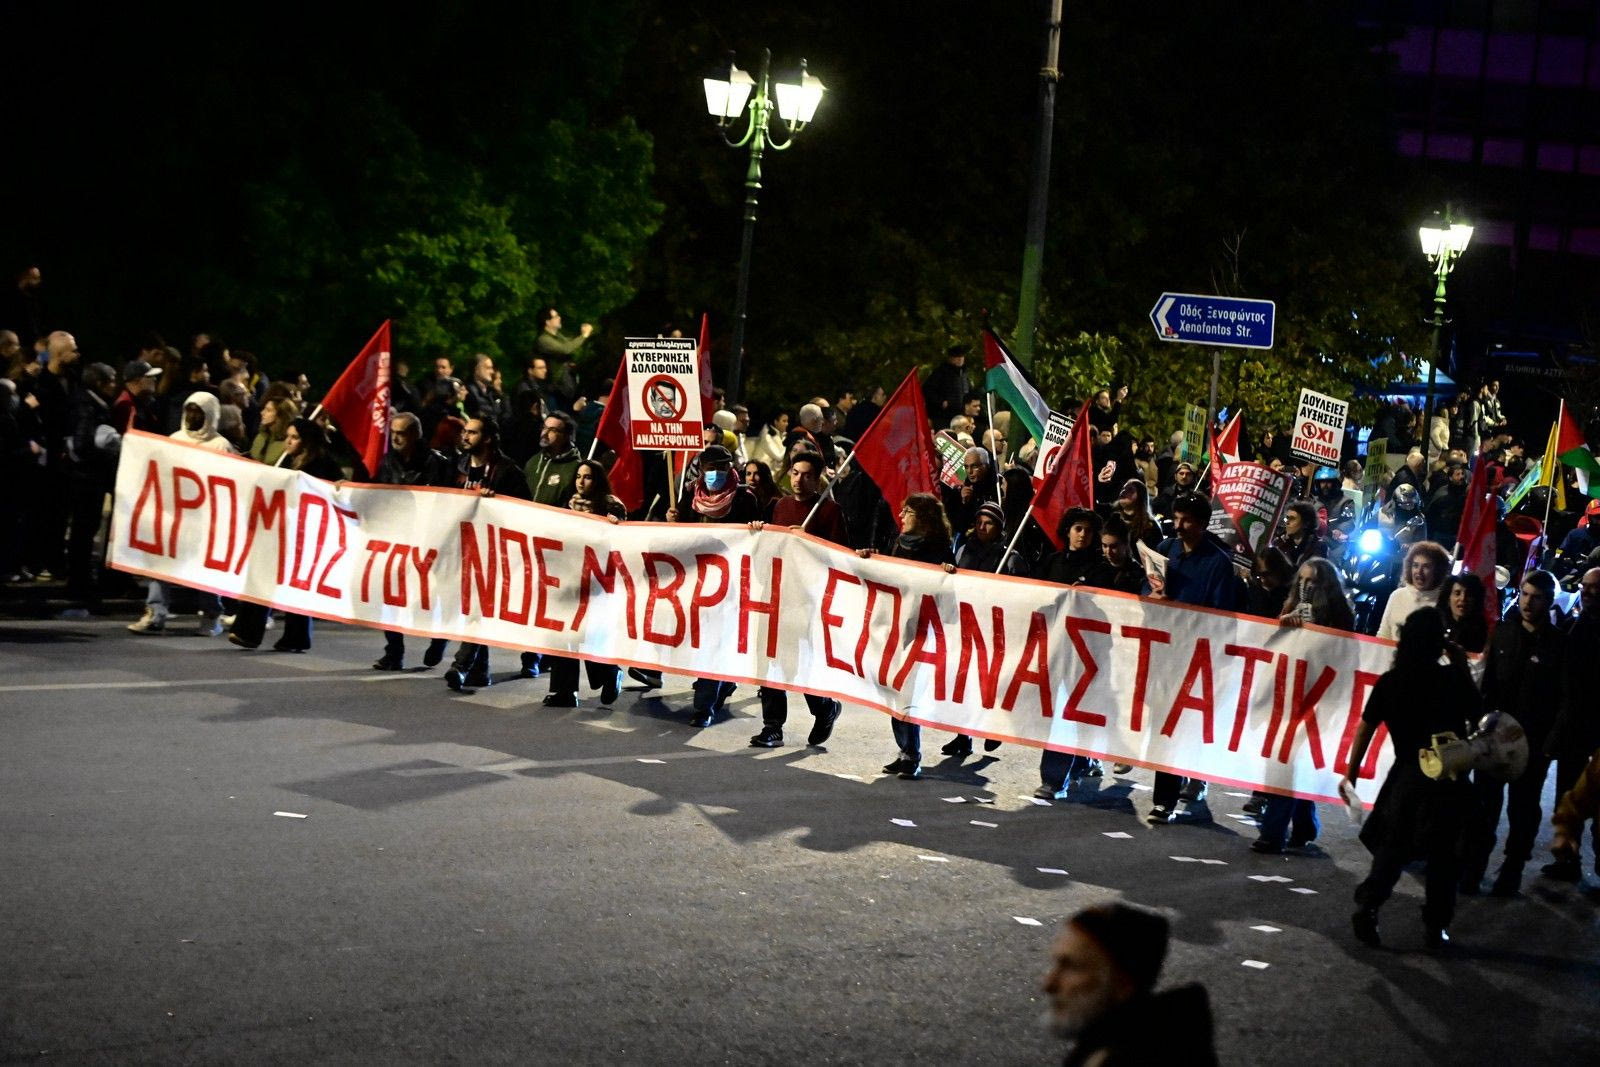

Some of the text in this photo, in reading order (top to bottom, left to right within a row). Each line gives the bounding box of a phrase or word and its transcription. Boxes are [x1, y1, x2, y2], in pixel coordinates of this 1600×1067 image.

[1180, 304, 1266, 325] Οδός Ξενοφώντος
[1179, 320, 1253, 338] Xenofontos Str.
[631, 363, 693, 374] ΔΟΛΟΦΟΝΩΝ
[632, 352, 690, 363] ΚΥΒΕΡΝΗΣΗ
[1302, 393, 1346, 417] ΔΟΥΛΕΙΕΣ
[650, 422, 683, 434] ΝΑ ΤΗΝ
[1300, 406, 1344, 429] ΑΥΞΗΣΕΙΣ
[636, 433, 700, 446] ΑΝΑΤΡΕΨΟΥΜΕ
[1293, 436, 1339, 460] ΠΟΛΕΜΟ
[1223, 464, 1284, 490] ΛΕΥΤΕΡΙΑ
[1217, 482, 1280, 506] ΠΑΛΑΙΣΤΙΝΗ
[130, 460, 359, 599] ΔΡΟΜΟΣ
[361, 540, 438, 612] ΤΟΥ
[460, 523, 783, 658] ΝΟΕΜΒΡΗ
